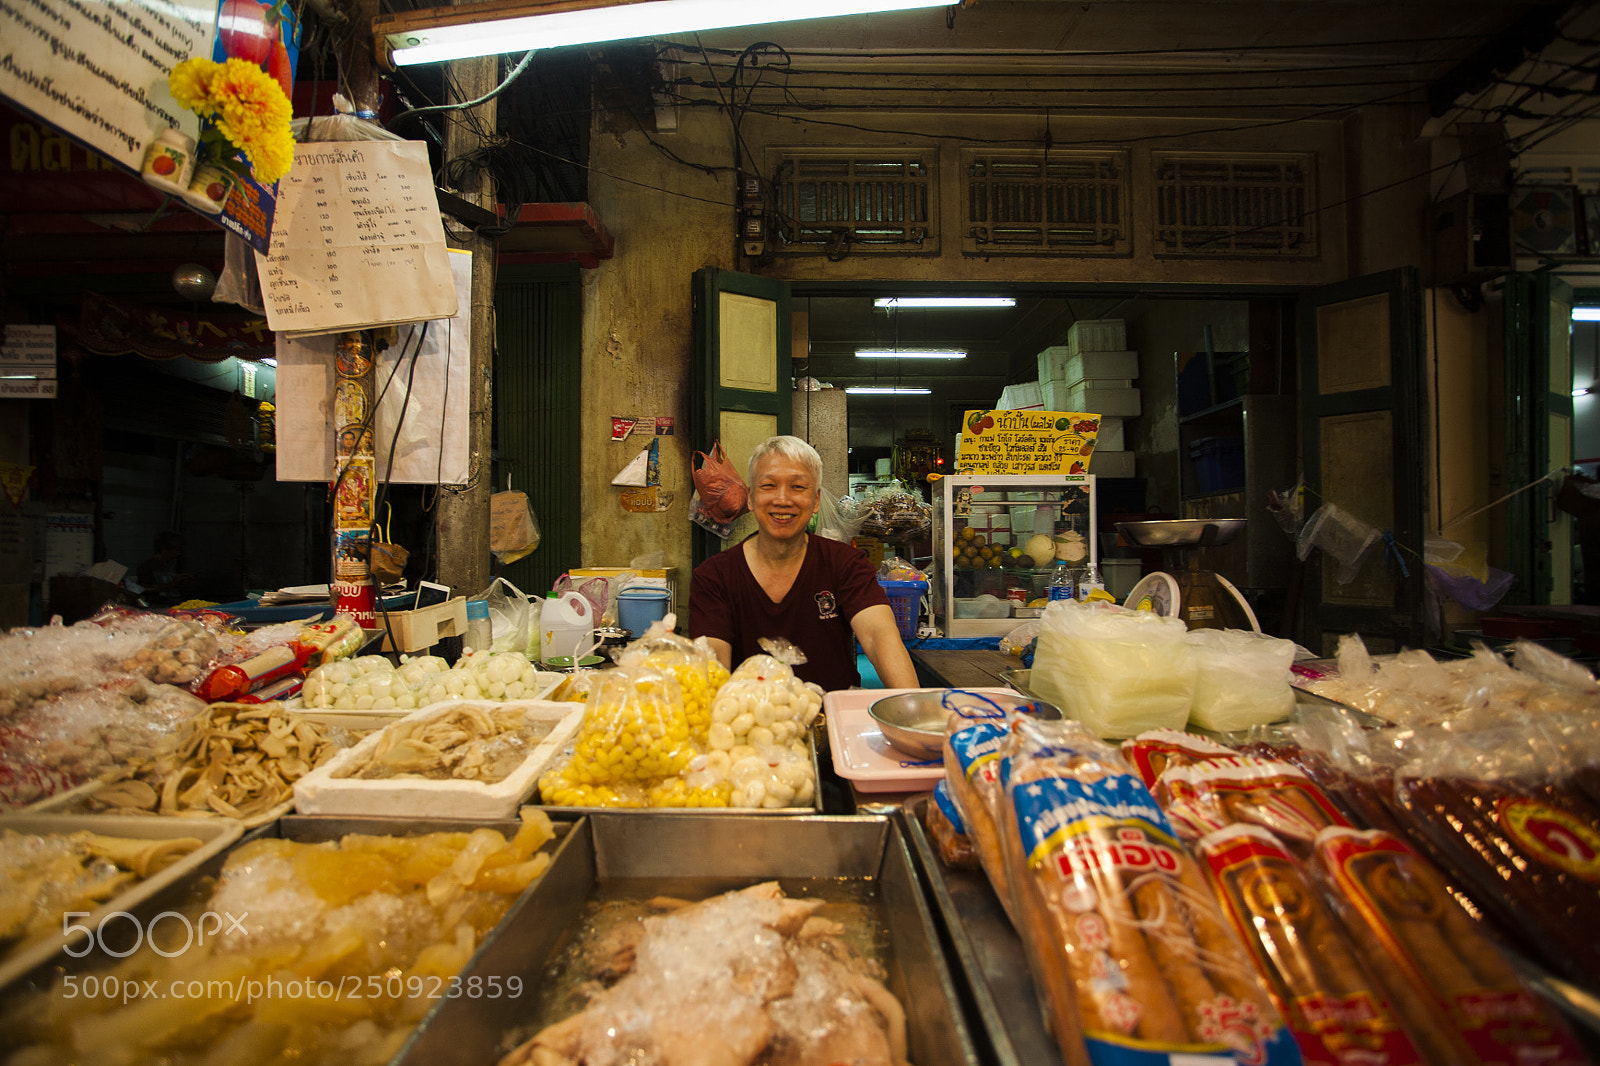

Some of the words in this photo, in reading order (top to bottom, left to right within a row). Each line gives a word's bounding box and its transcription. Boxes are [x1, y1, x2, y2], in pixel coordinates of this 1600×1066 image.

[294, 148, 365, 166] รายการสินค้า
